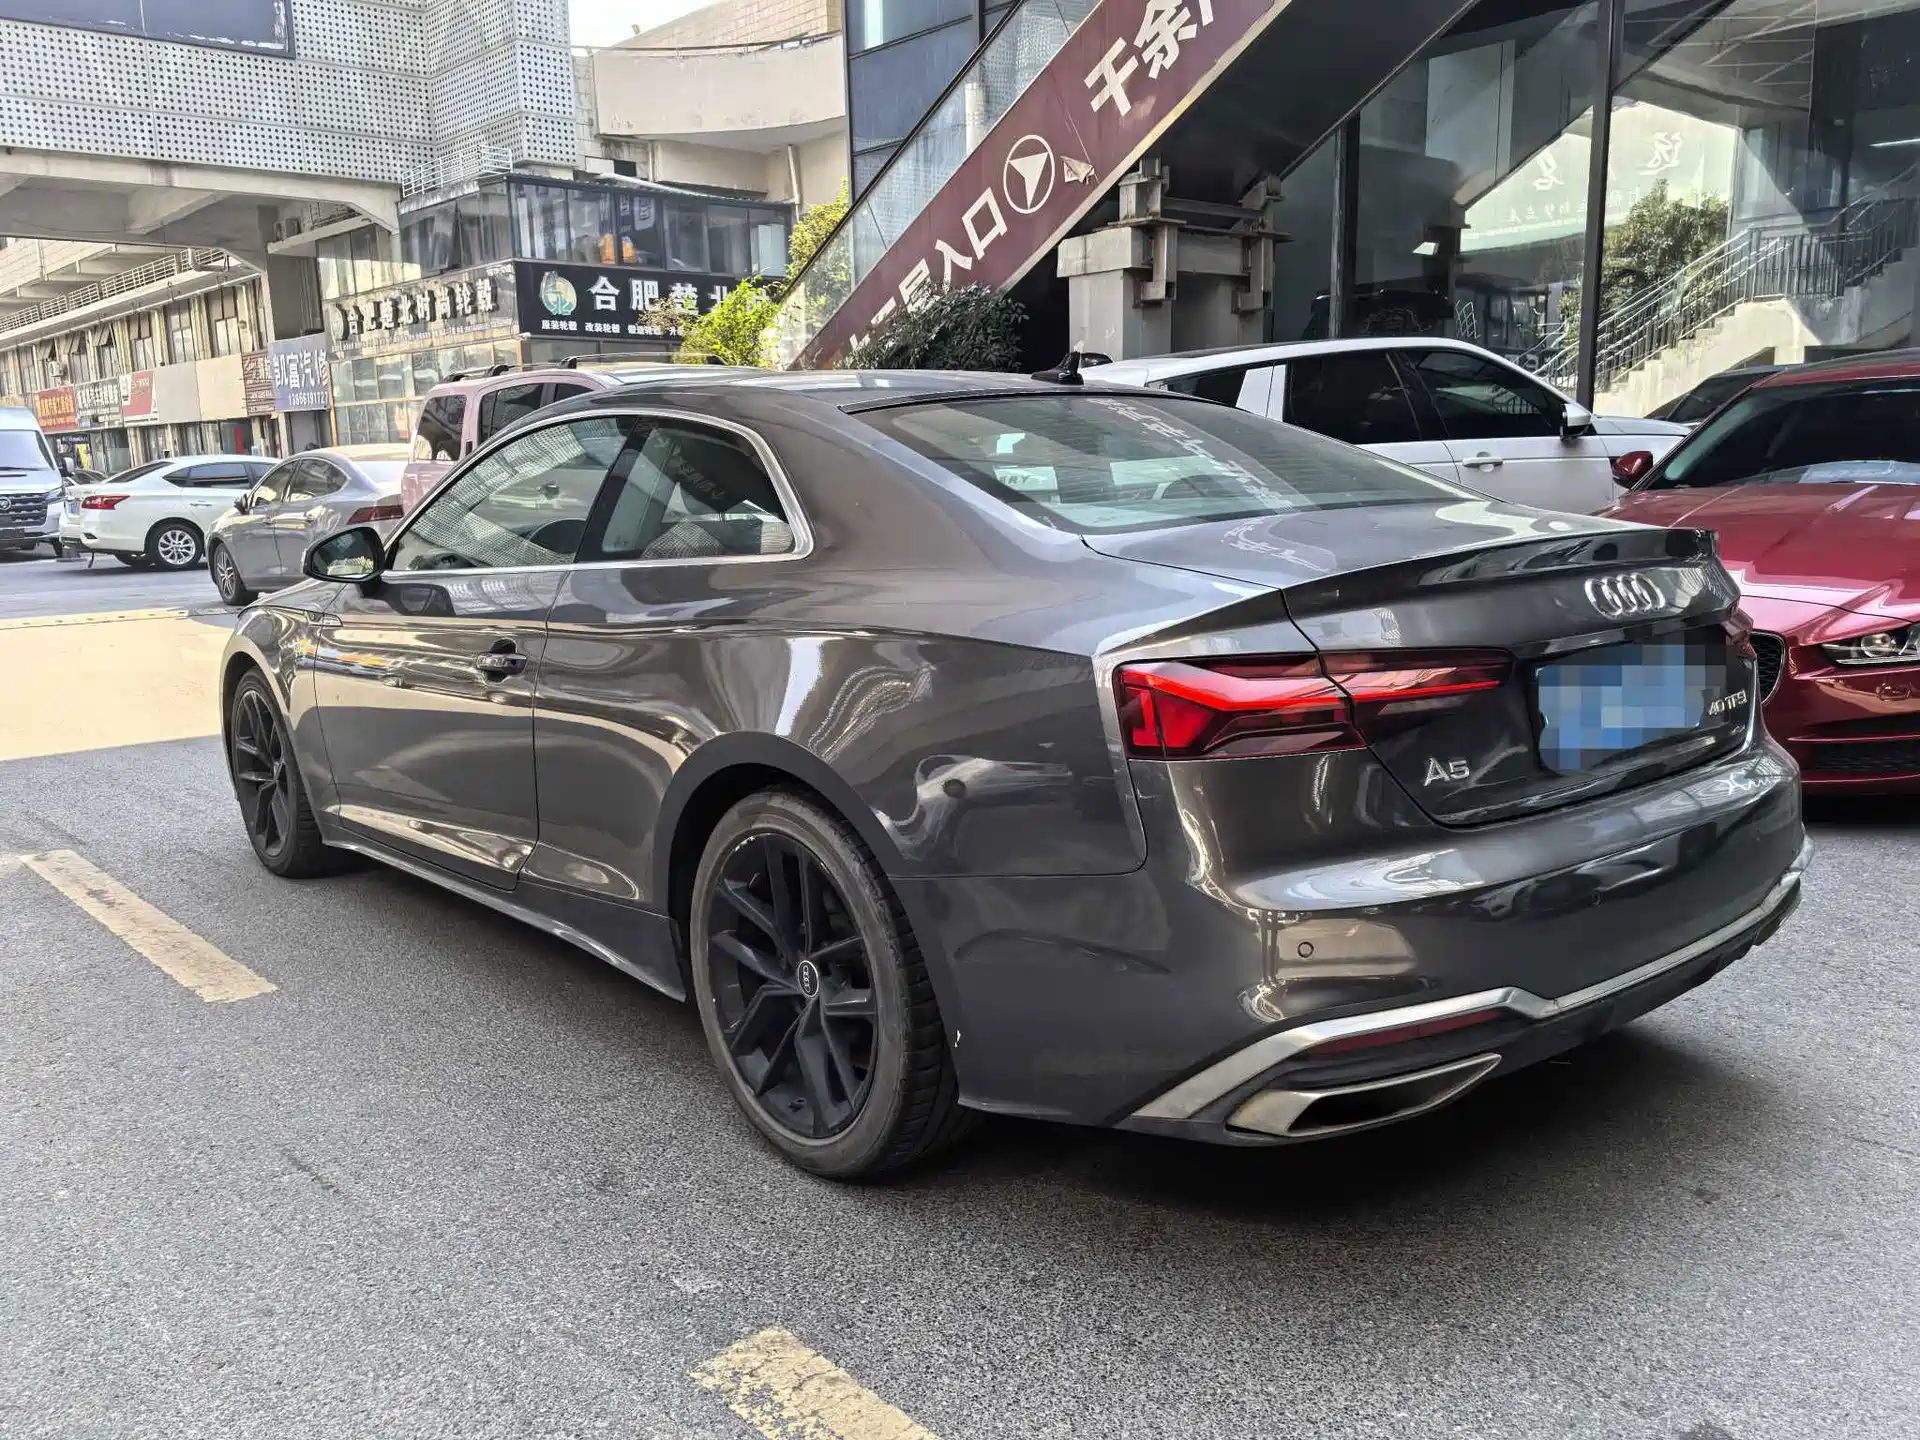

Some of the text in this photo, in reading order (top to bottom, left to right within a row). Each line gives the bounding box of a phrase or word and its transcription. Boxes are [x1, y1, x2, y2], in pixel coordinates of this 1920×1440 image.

[1084, 0, 1214, 117] 千余
[541, 319, 578, 331] 原装轮毂
[584, 322, 620, 334] 改装轮毂
[273, 348, 328, 388] 凯富汽修
[1708, 689, 1748, 715] 40 TFSI
[1423, 757, 1470, 787] A5
